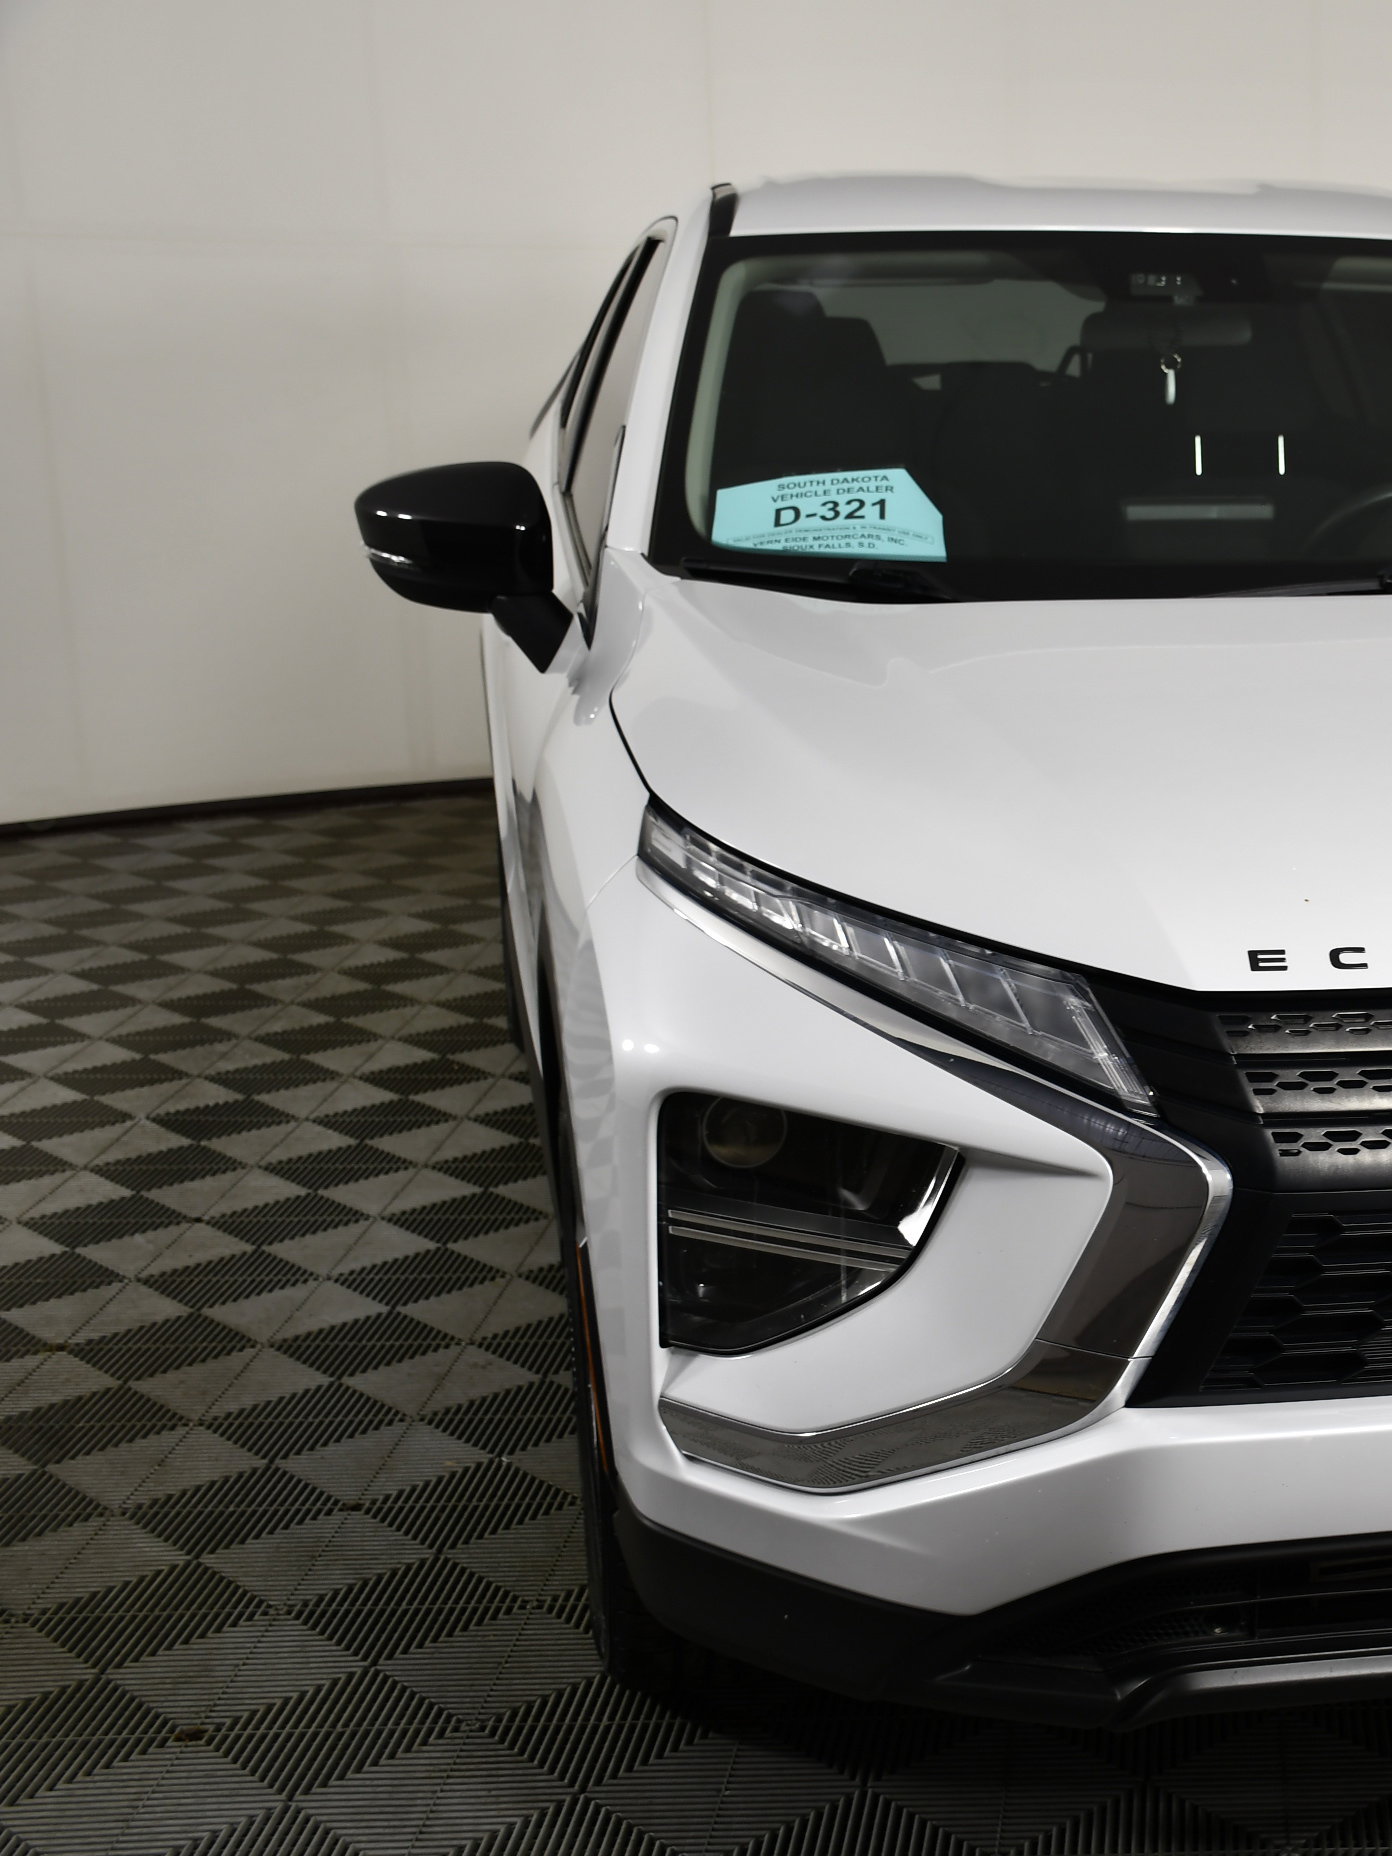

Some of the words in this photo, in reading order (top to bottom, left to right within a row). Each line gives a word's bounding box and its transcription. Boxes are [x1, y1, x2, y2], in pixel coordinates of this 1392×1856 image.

[777, 479, 826, 491] SOUTH
[830, 475, 890, 485] DAKOTA
[771, 489, 831, 503] VEHICLE
[836, 485, 895, 495] DEALER
[773, 498, 887, 528] D-321
